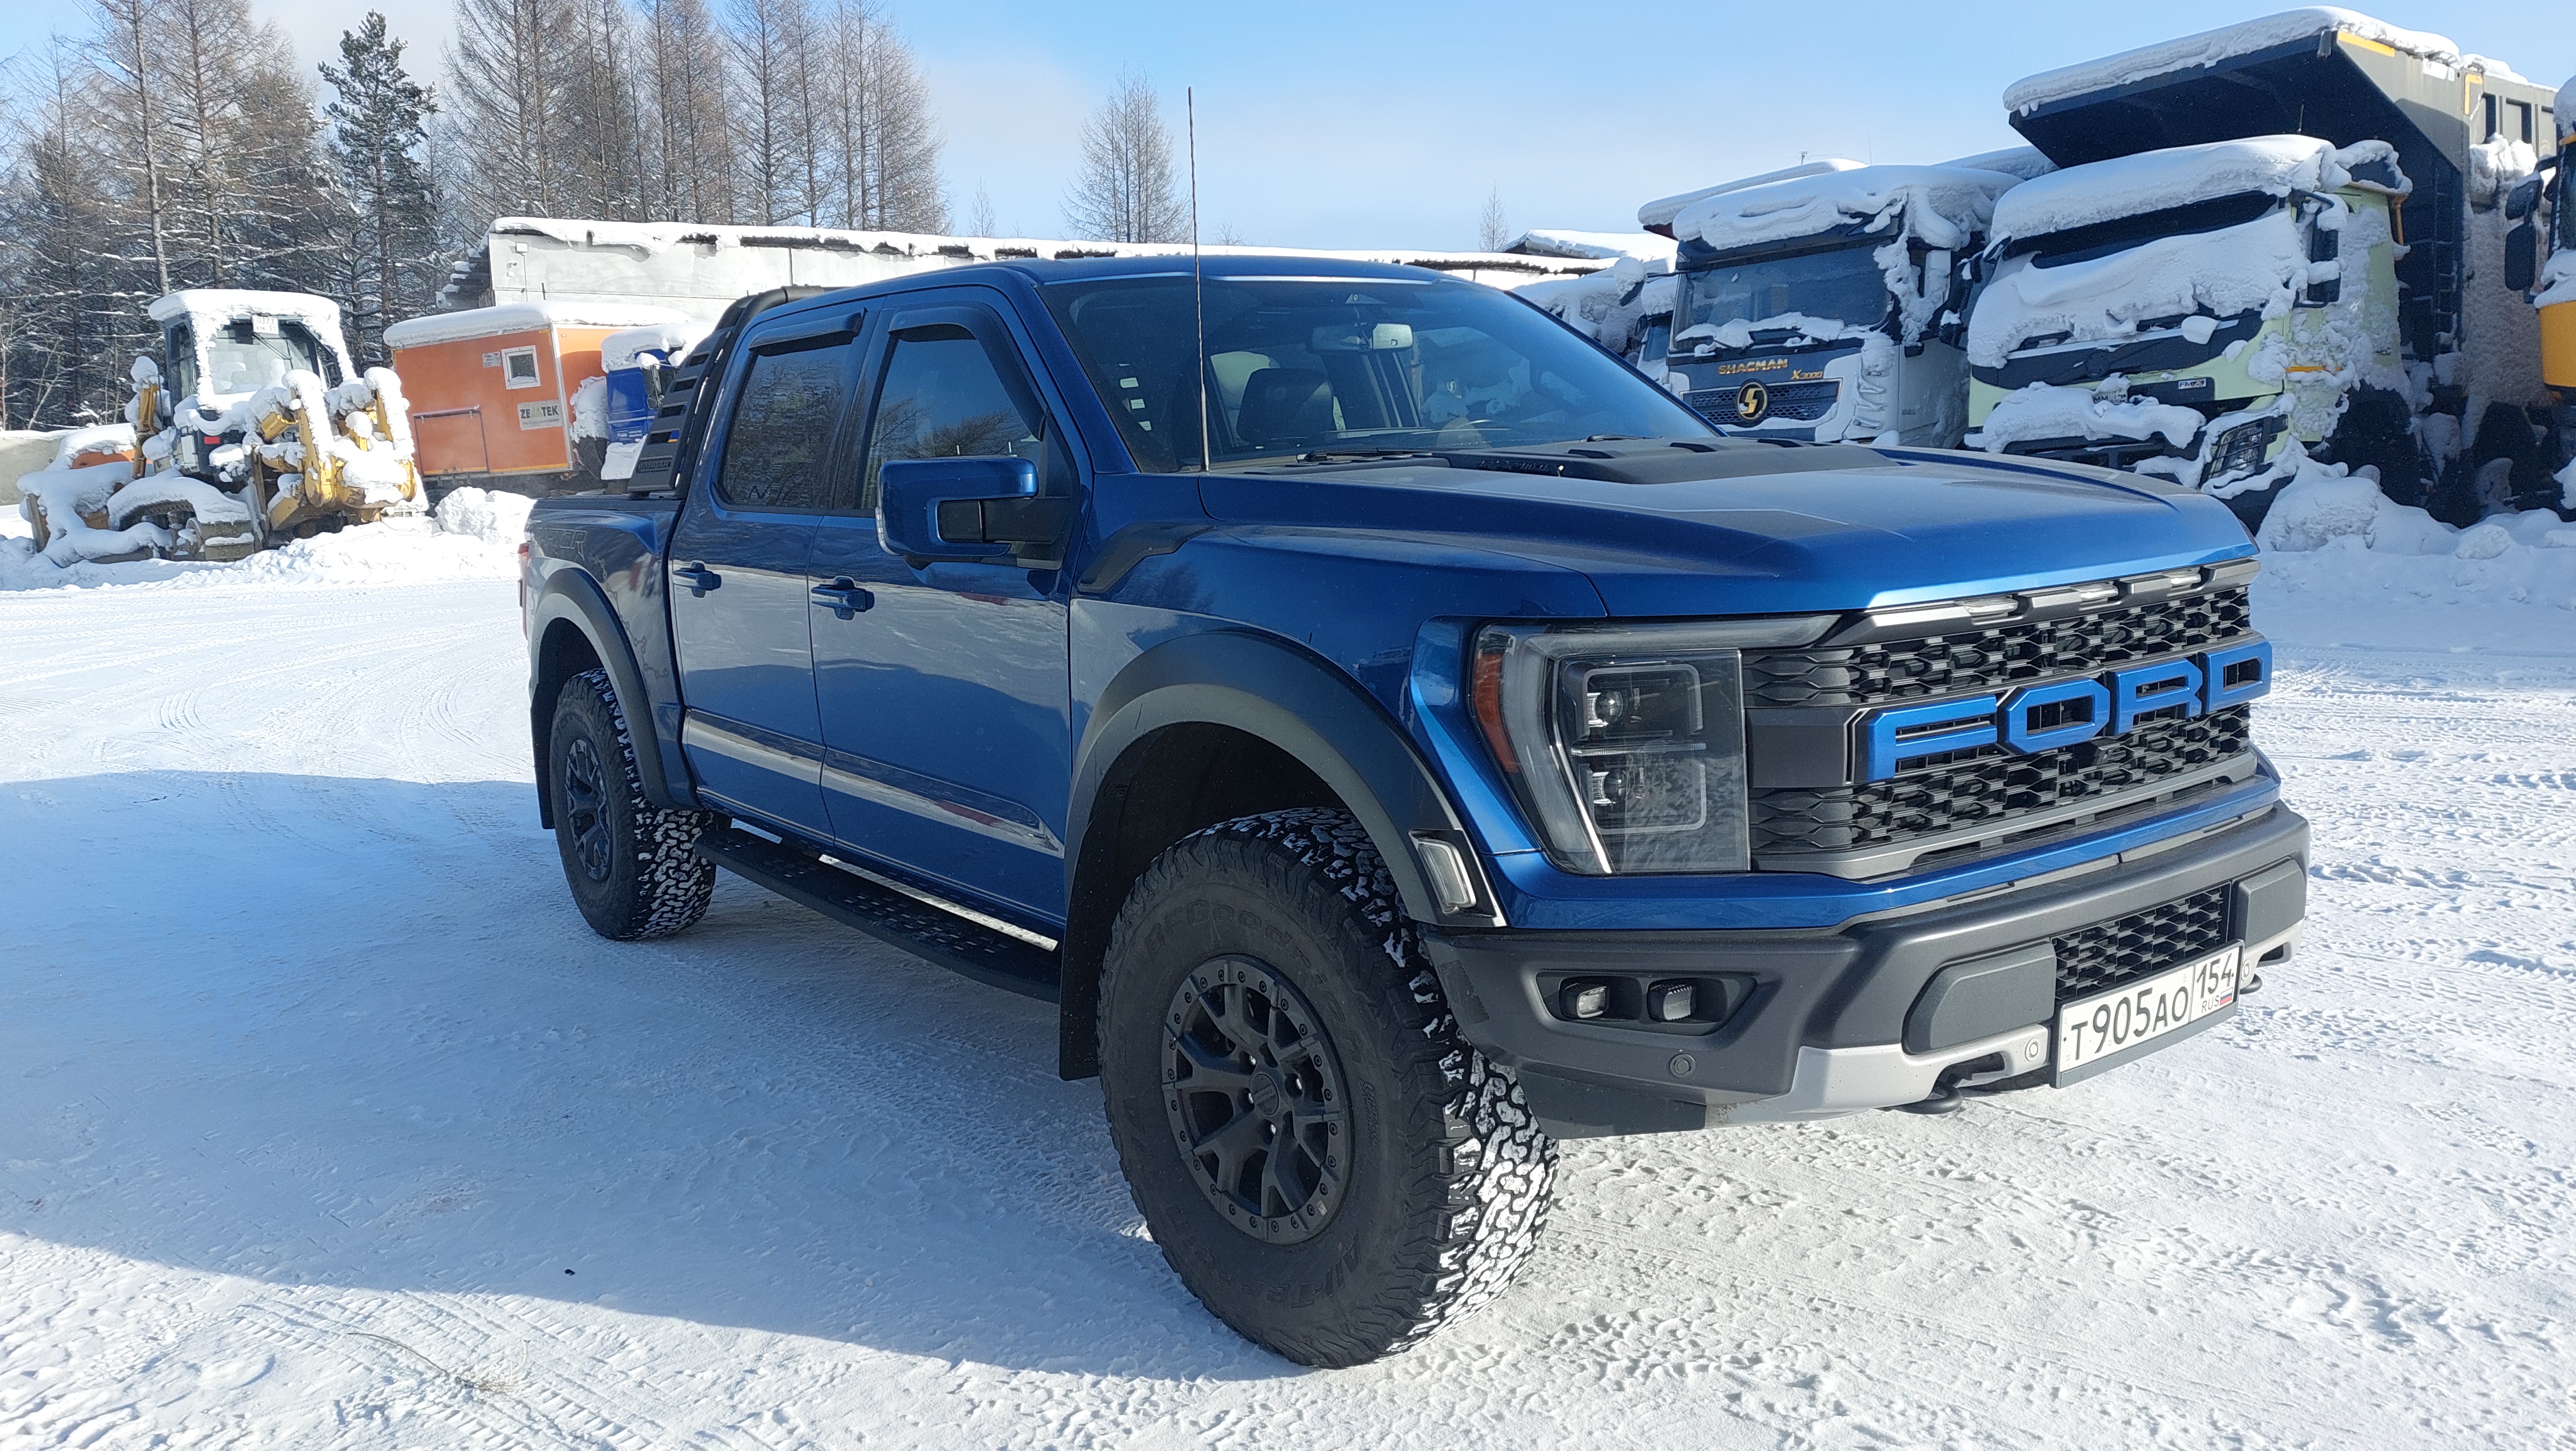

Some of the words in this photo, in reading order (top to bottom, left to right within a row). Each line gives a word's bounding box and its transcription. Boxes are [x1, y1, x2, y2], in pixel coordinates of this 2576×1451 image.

[1718, 358, 1788, 375] SHACMAN
[1790, 368, 1823, 380] X3000
[1867, 640, 2273, 782] FORD
[2196, 953, 2232, 999] 154
[2202, 995, 2220, 1014] RUS
